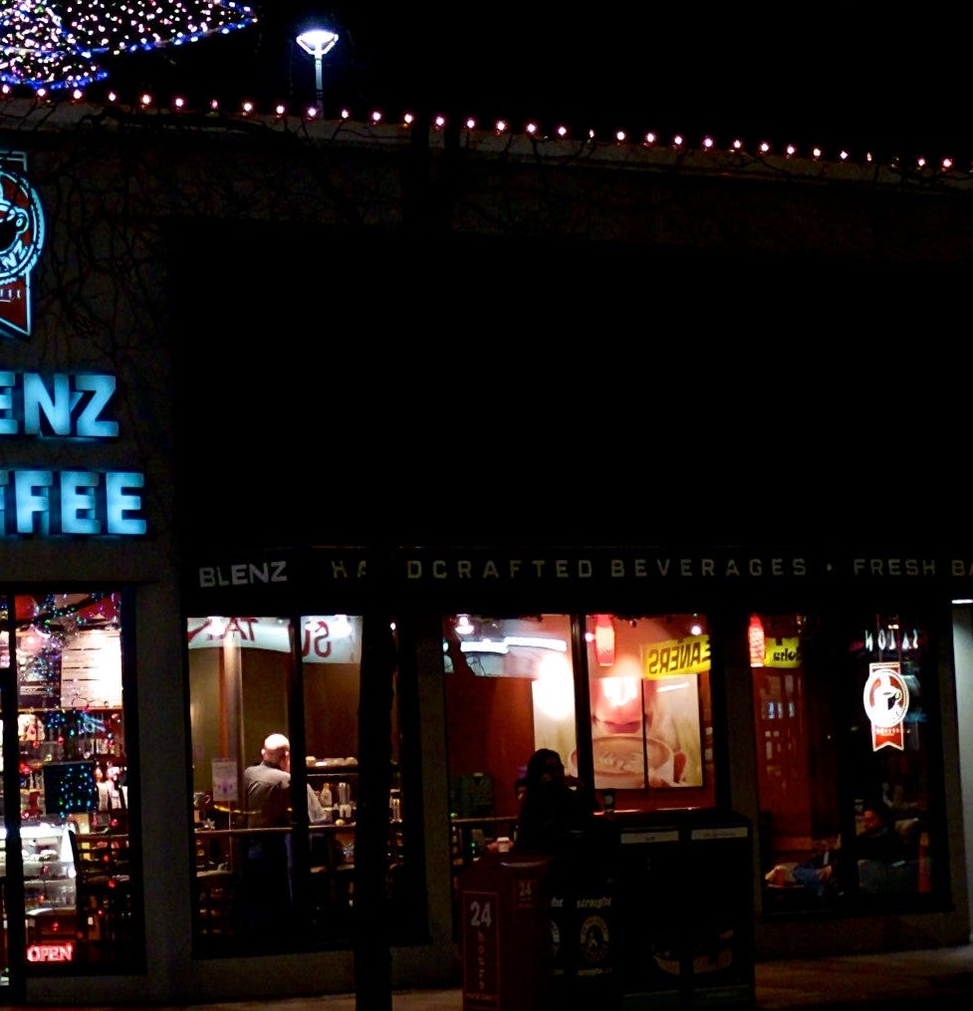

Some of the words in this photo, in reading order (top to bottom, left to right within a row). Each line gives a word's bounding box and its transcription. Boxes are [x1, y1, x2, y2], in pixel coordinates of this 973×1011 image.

[198, 560, 289, 588] BLENZ
[331, 558, 593, 580] HADCRAFTED
[610, 558, 808, 578] BEVERAGES
[853, 557, 936, 577] FRESH
[470, 901, 492, 925] 24
[27, 943, 73, 961] OPEN
